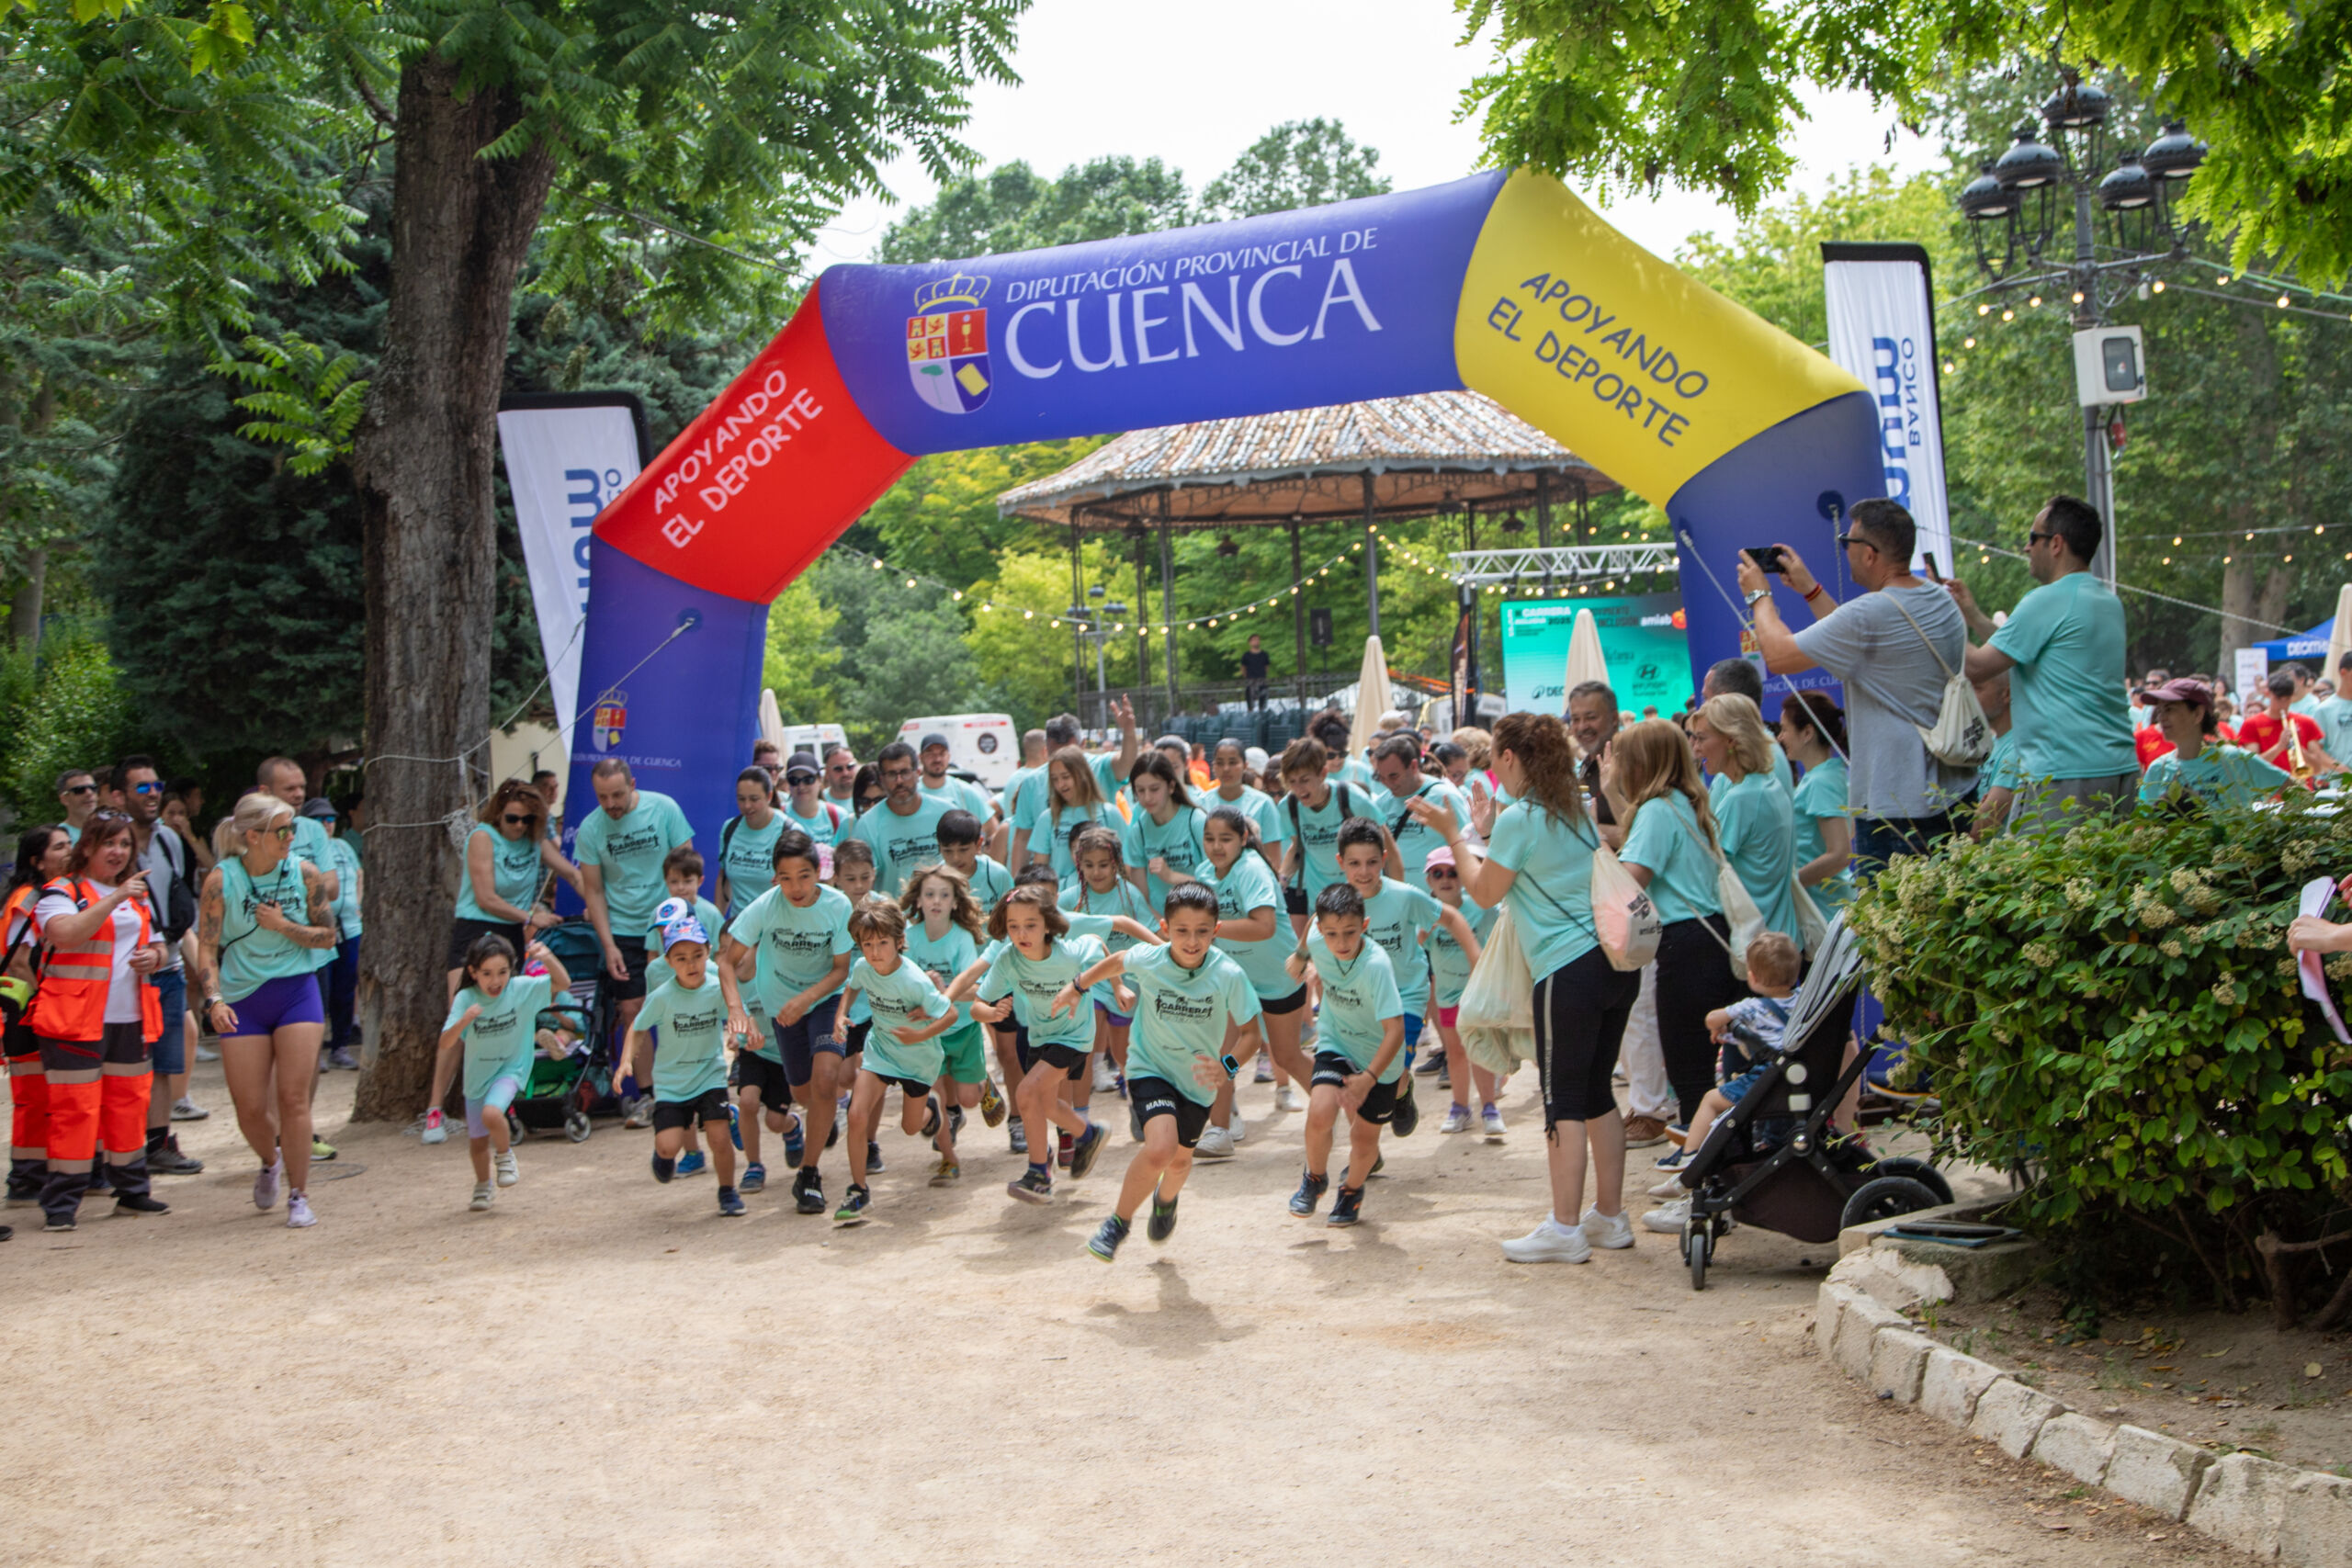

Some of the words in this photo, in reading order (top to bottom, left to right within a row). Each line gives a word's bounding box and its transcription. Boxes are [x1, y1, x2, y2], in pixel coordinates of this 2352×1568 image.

[1004, 258, 1383, 378] CUENCA
[1006, 259, 1167, 303] DIPUTACIÓN
[1174, 240, 1331, 279] PROVINCIAL
[1340, 228, 1378, 254] DE
[1487, 296, 1523, 343] EL
[1534, 331, 1690, 447] DEPORTE
[1520, 272, 1709, 399] APOYANDO
[654, 370, 787, 514] APOYANDO
[662, 513, 705, 548] EL
[699, 388, 823, 512] DEPORTE
[644, 757, 682, 768] CUENCA
